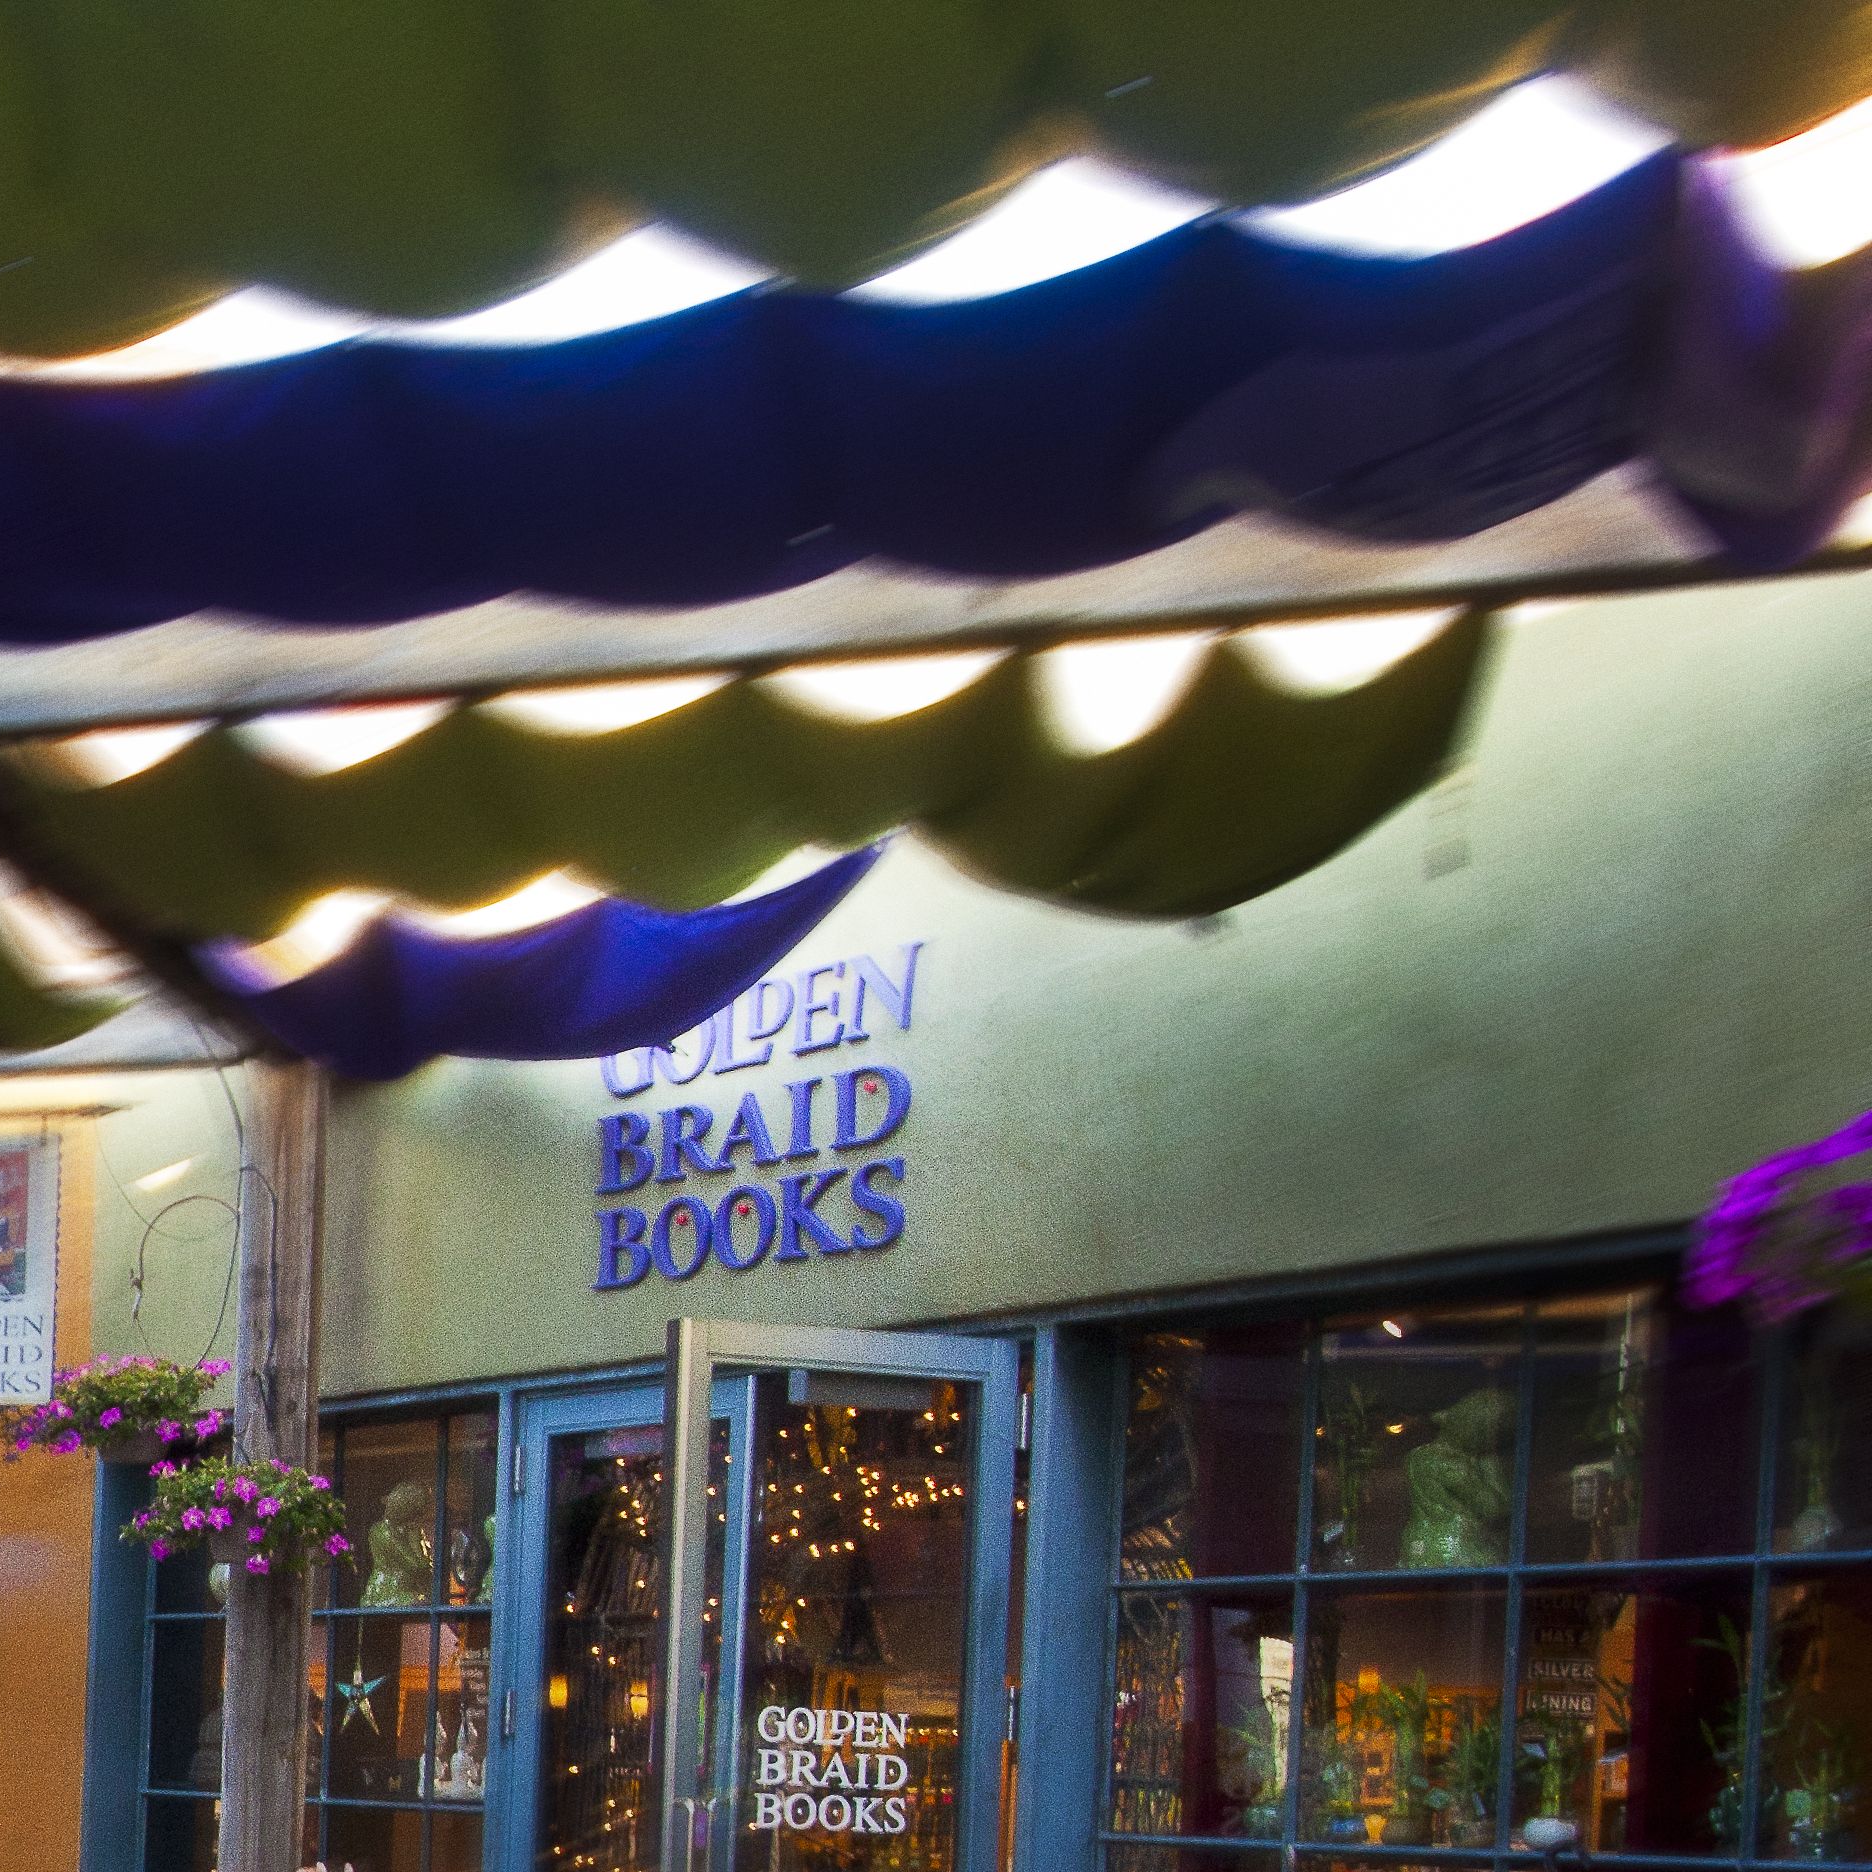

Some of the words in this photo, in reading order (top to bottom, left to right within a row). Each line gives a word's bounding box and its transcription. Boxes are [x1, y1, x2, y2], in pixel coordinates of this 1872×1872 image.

[596, 1064, 913, 1197] BRAID
[591, 1156, 906, 1292] BOOKS
[757, 1705, 909, 1748] GOLDEN
[756, 1749, 908, 1790] BRAID
[755, 1793, 906, 1834] BOOKS
